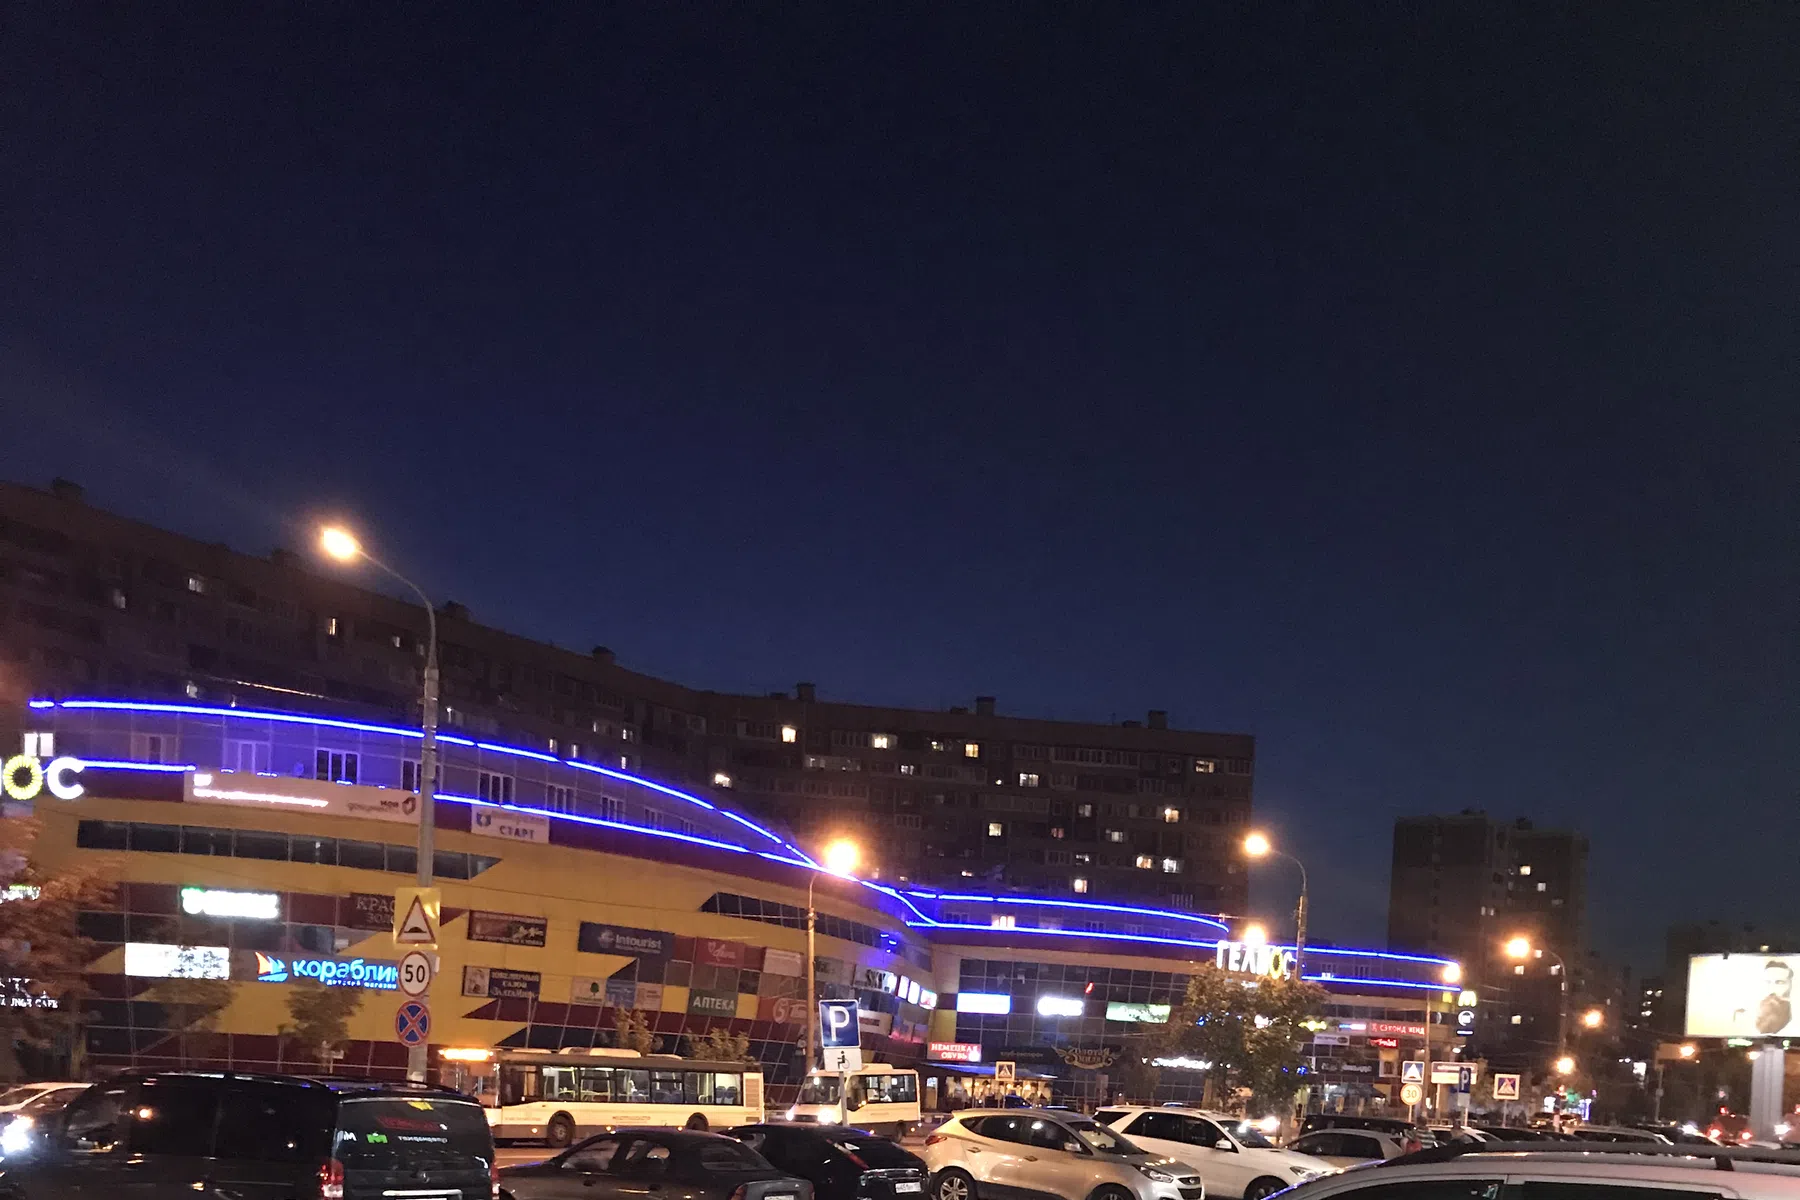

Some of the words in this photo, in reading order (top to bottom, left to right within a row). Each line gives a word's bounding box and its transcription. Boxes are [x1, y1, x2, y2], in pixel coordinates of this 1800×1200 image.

[0, 755, 84, 800] ОС
[499, 825, 535, 839] СТАРТ
[615, 934, 662, 949] Intourist
[404, 964, 425, 983] 50
[692, 996, 736, 1010] АПТЕКА
[829, 1005, 850, 1042] P
[941, 1051, 968, 1060] ОБУВЬ
[1461, 1070, 1469, 1091] P
[1406, 1089, 1418, 1099] 30
